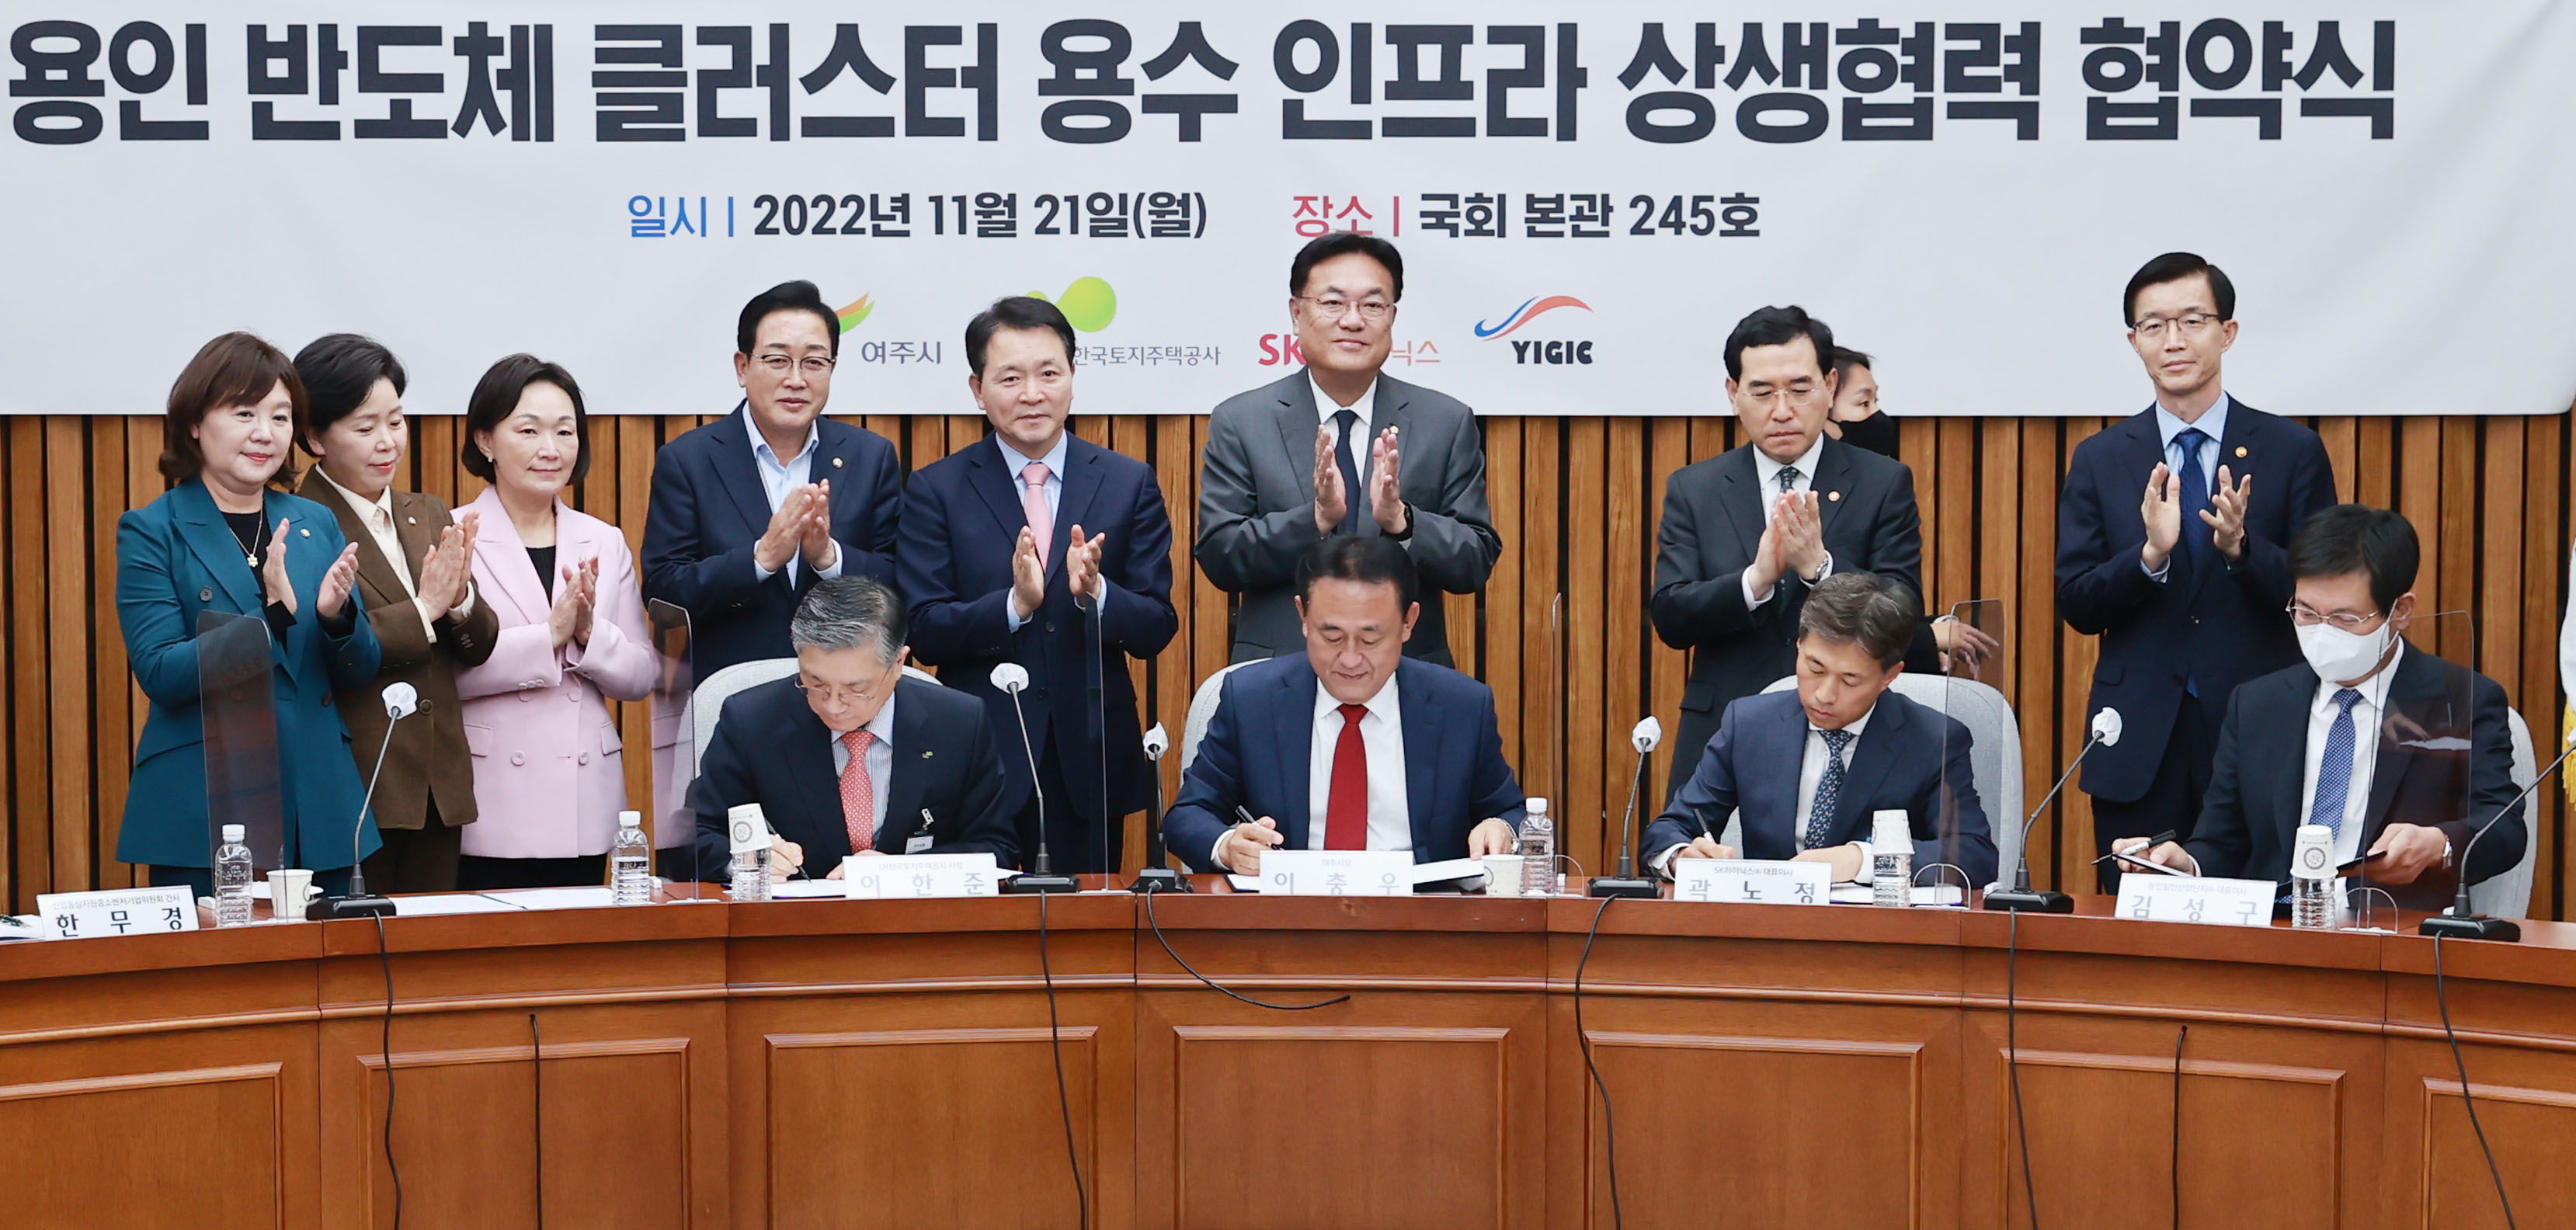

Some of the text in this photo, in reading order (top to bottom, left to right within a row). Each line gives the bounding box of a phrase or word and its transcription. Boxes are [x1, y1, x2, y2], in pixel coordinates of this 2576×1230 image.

[9, 17, 2396, 145] 용인 반도체 클러스터 용수 인프라 상생협력 협약식
[627, 191, 1207, 239] 일시 2022년 11월 21일(월)
[1292, 192, 1761, 238] 장소 국회 본관 245호
[861, 341, 942, 366] 여주시
[1074, 346, 1222, 367] 한국토지주택공사
[1511, 341, 1594, 365] YIGIC
